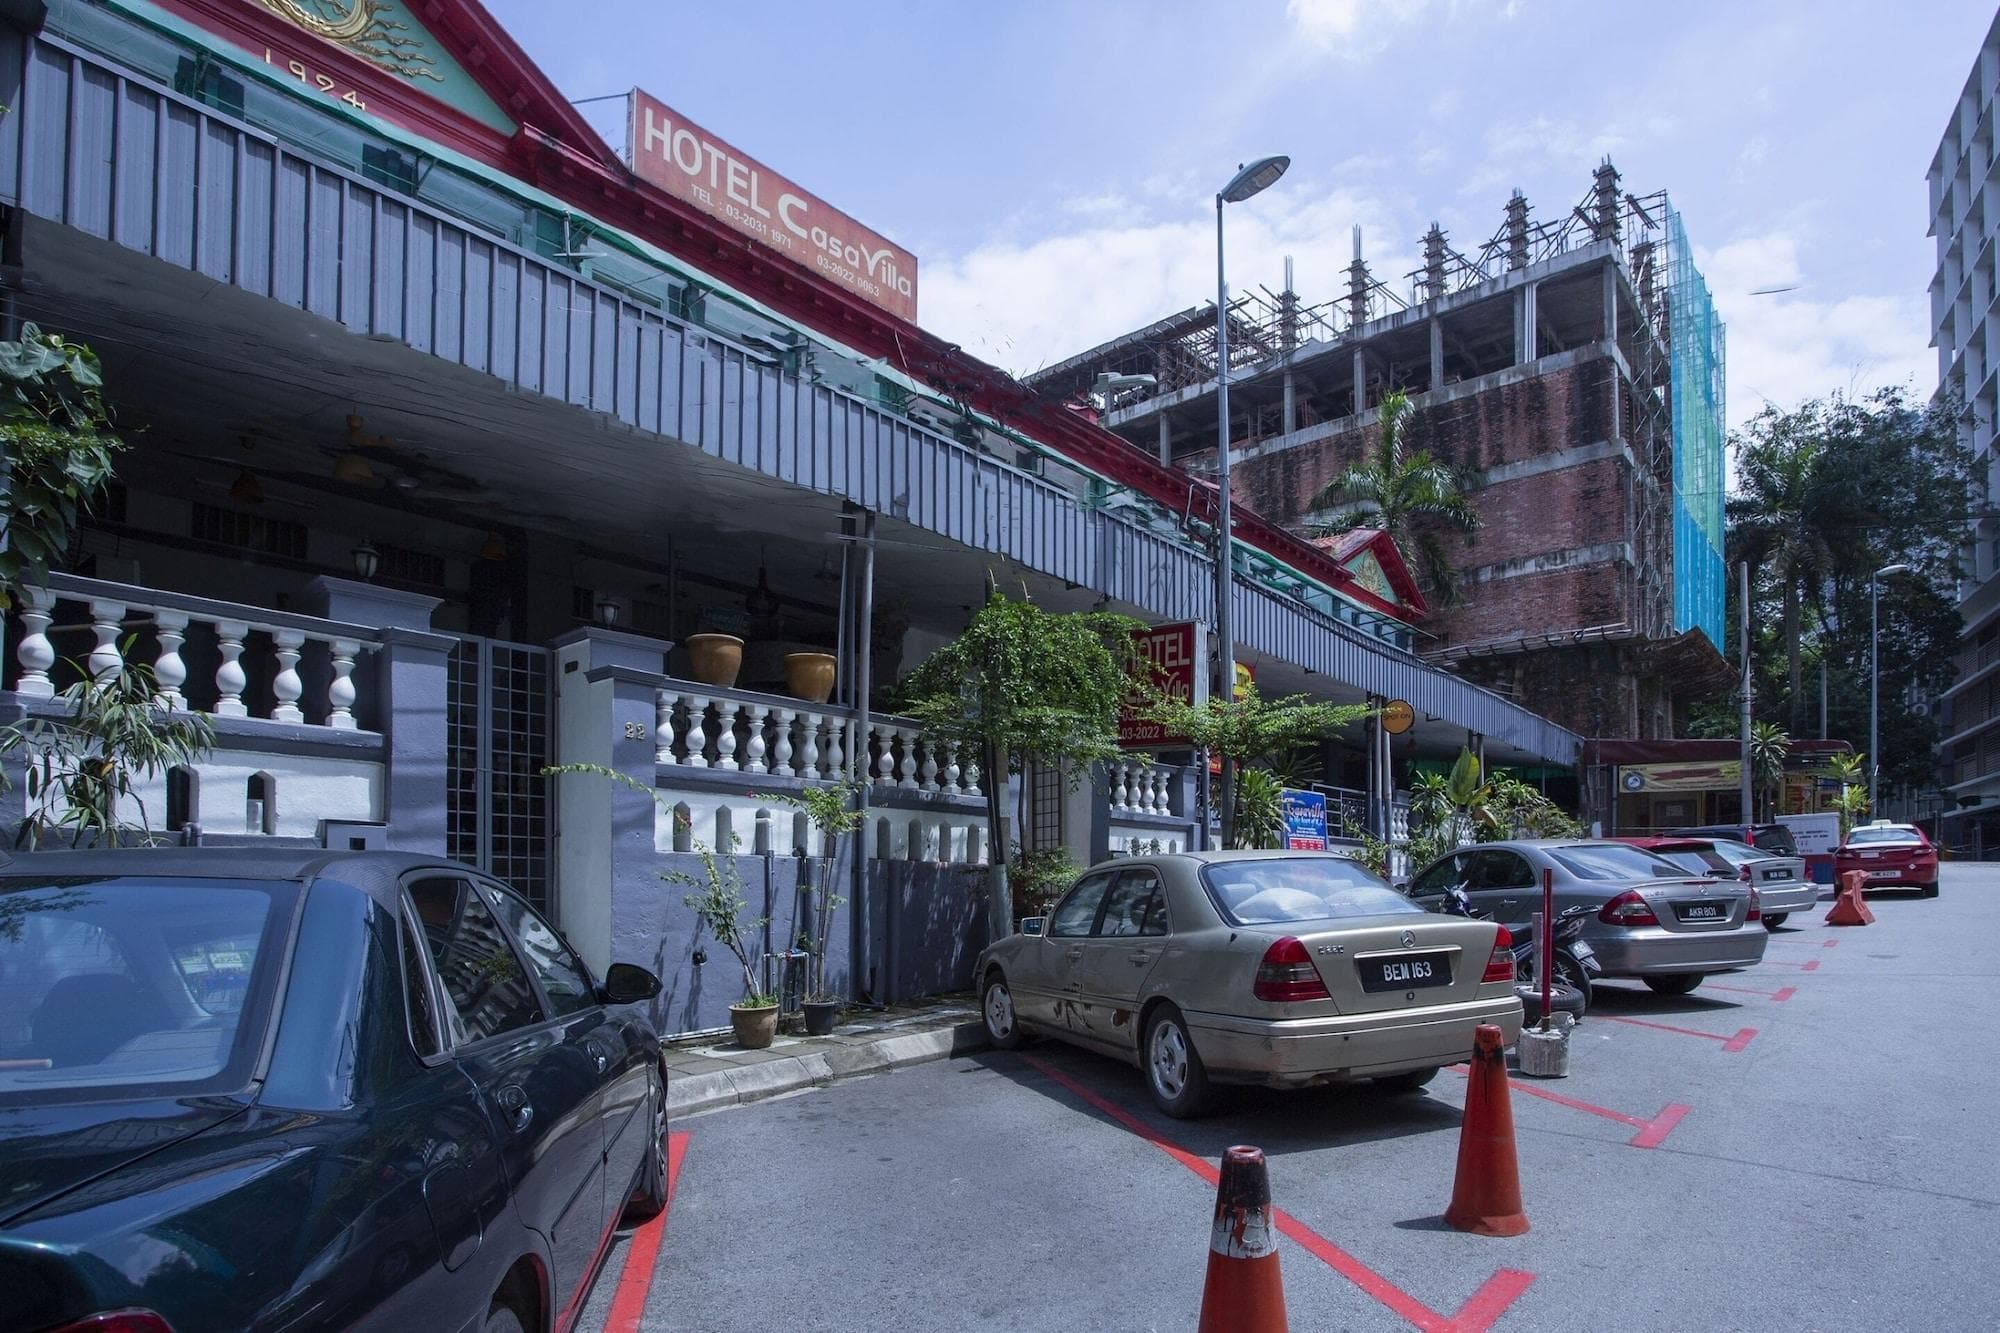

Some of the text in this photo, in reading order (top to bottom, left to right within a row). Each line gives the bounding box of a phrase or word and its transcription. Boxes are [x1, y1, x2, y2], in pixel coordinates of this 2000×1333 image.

[643, 106, 771, 219] HOTEL
[691, 183, 714, 208] TEL
[725, 204, 767, 236] 03-2031
[771, 228, 792, 250] 1971
[816, 254, 855, 286] 03-2022
[624, 721, 646, 740] 22
[1383, 961, 1432, 982] BEM 163
